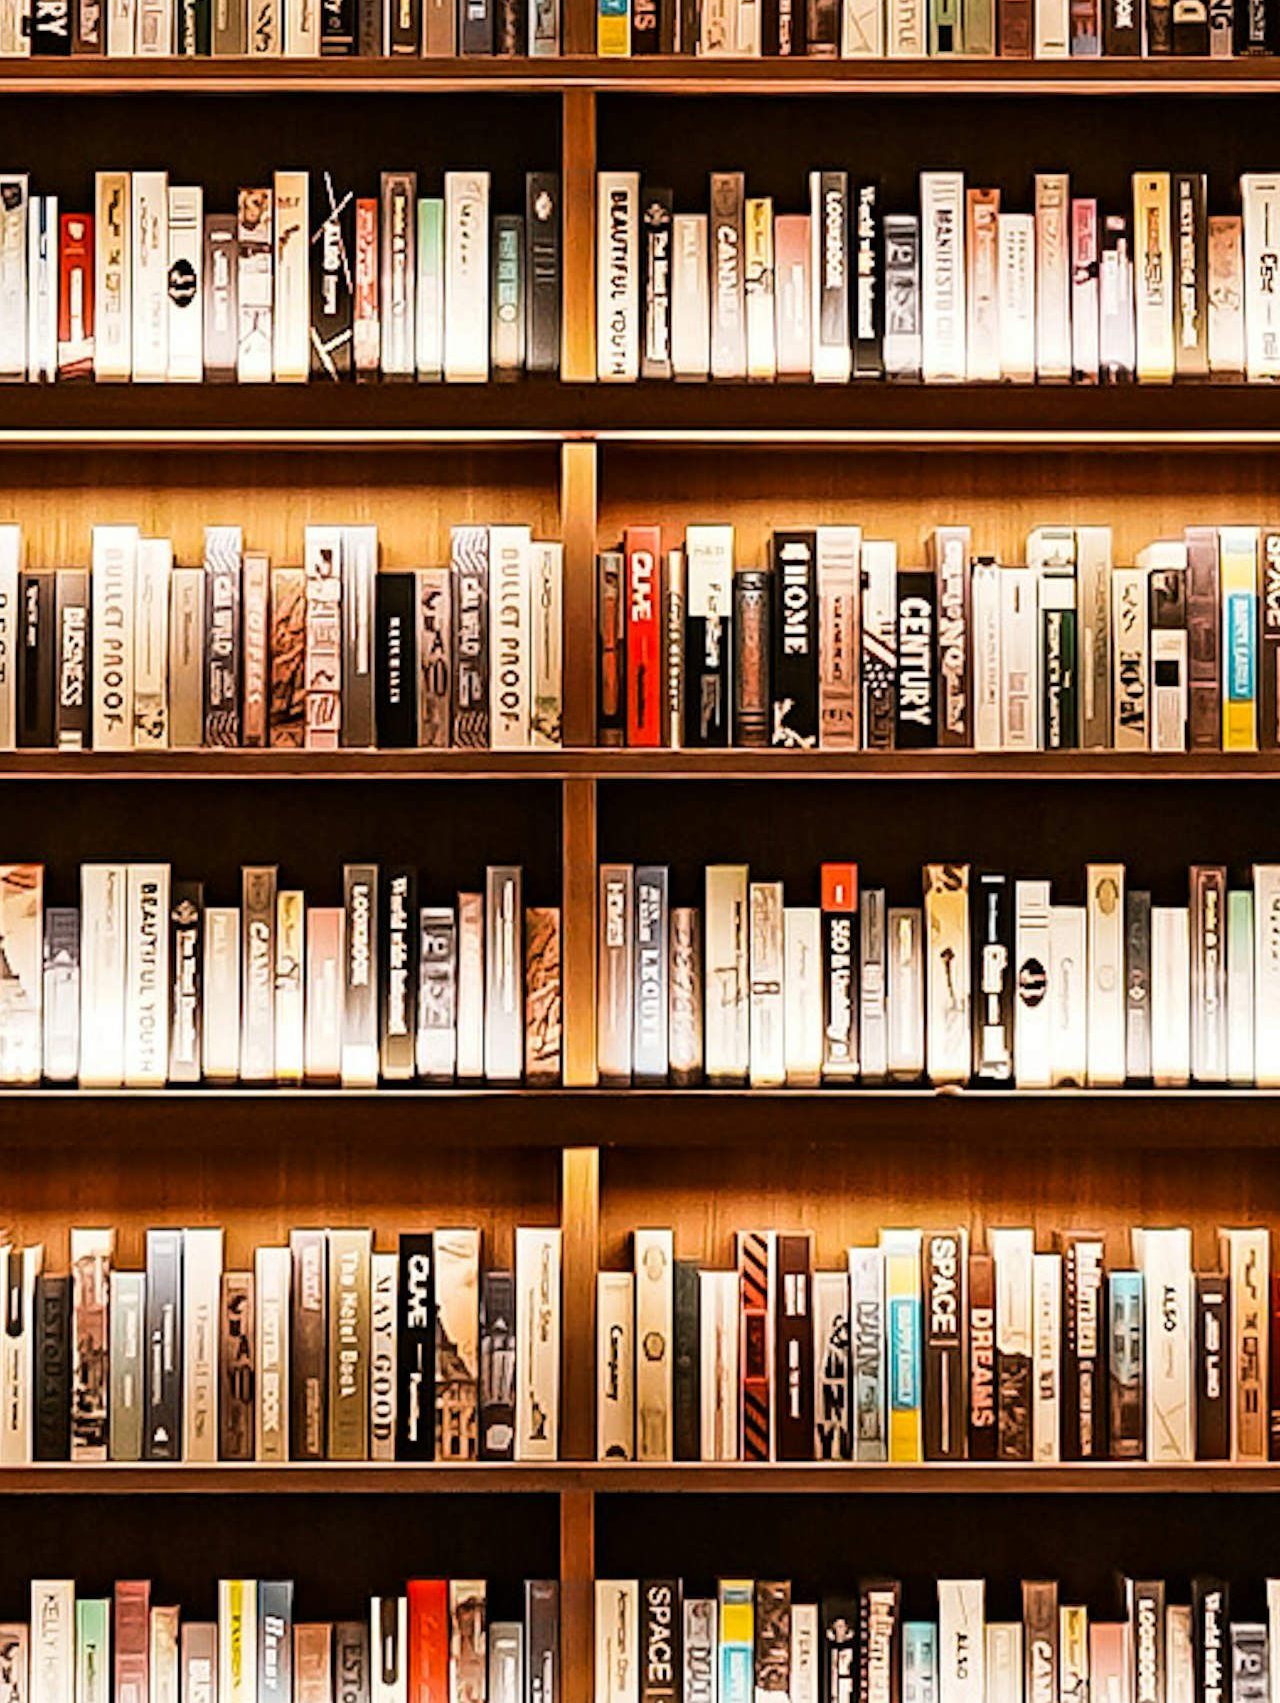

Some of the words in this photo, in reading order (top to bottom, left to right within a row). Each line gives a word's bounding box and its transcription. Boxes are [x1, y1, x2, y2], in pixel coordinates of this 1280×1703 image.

[610, 191, 629, 299] BEAUTIFUL
[611, 310, 628, 375] YOUTH
[62, 607, 85, 705] BUSINESS
[900, 597, 931, 725] CENTURY
[139, 882, 158, 995] BEAUTIFUL
[339, 1252, 358, 1284] The
[931, 1238, 956, 1333] SPACE
[373, 1355, 391, 1441] GOOD
[971, 1309, 993, 1427] DREAMS
[647, 1586, 672, 1681] SPACE
